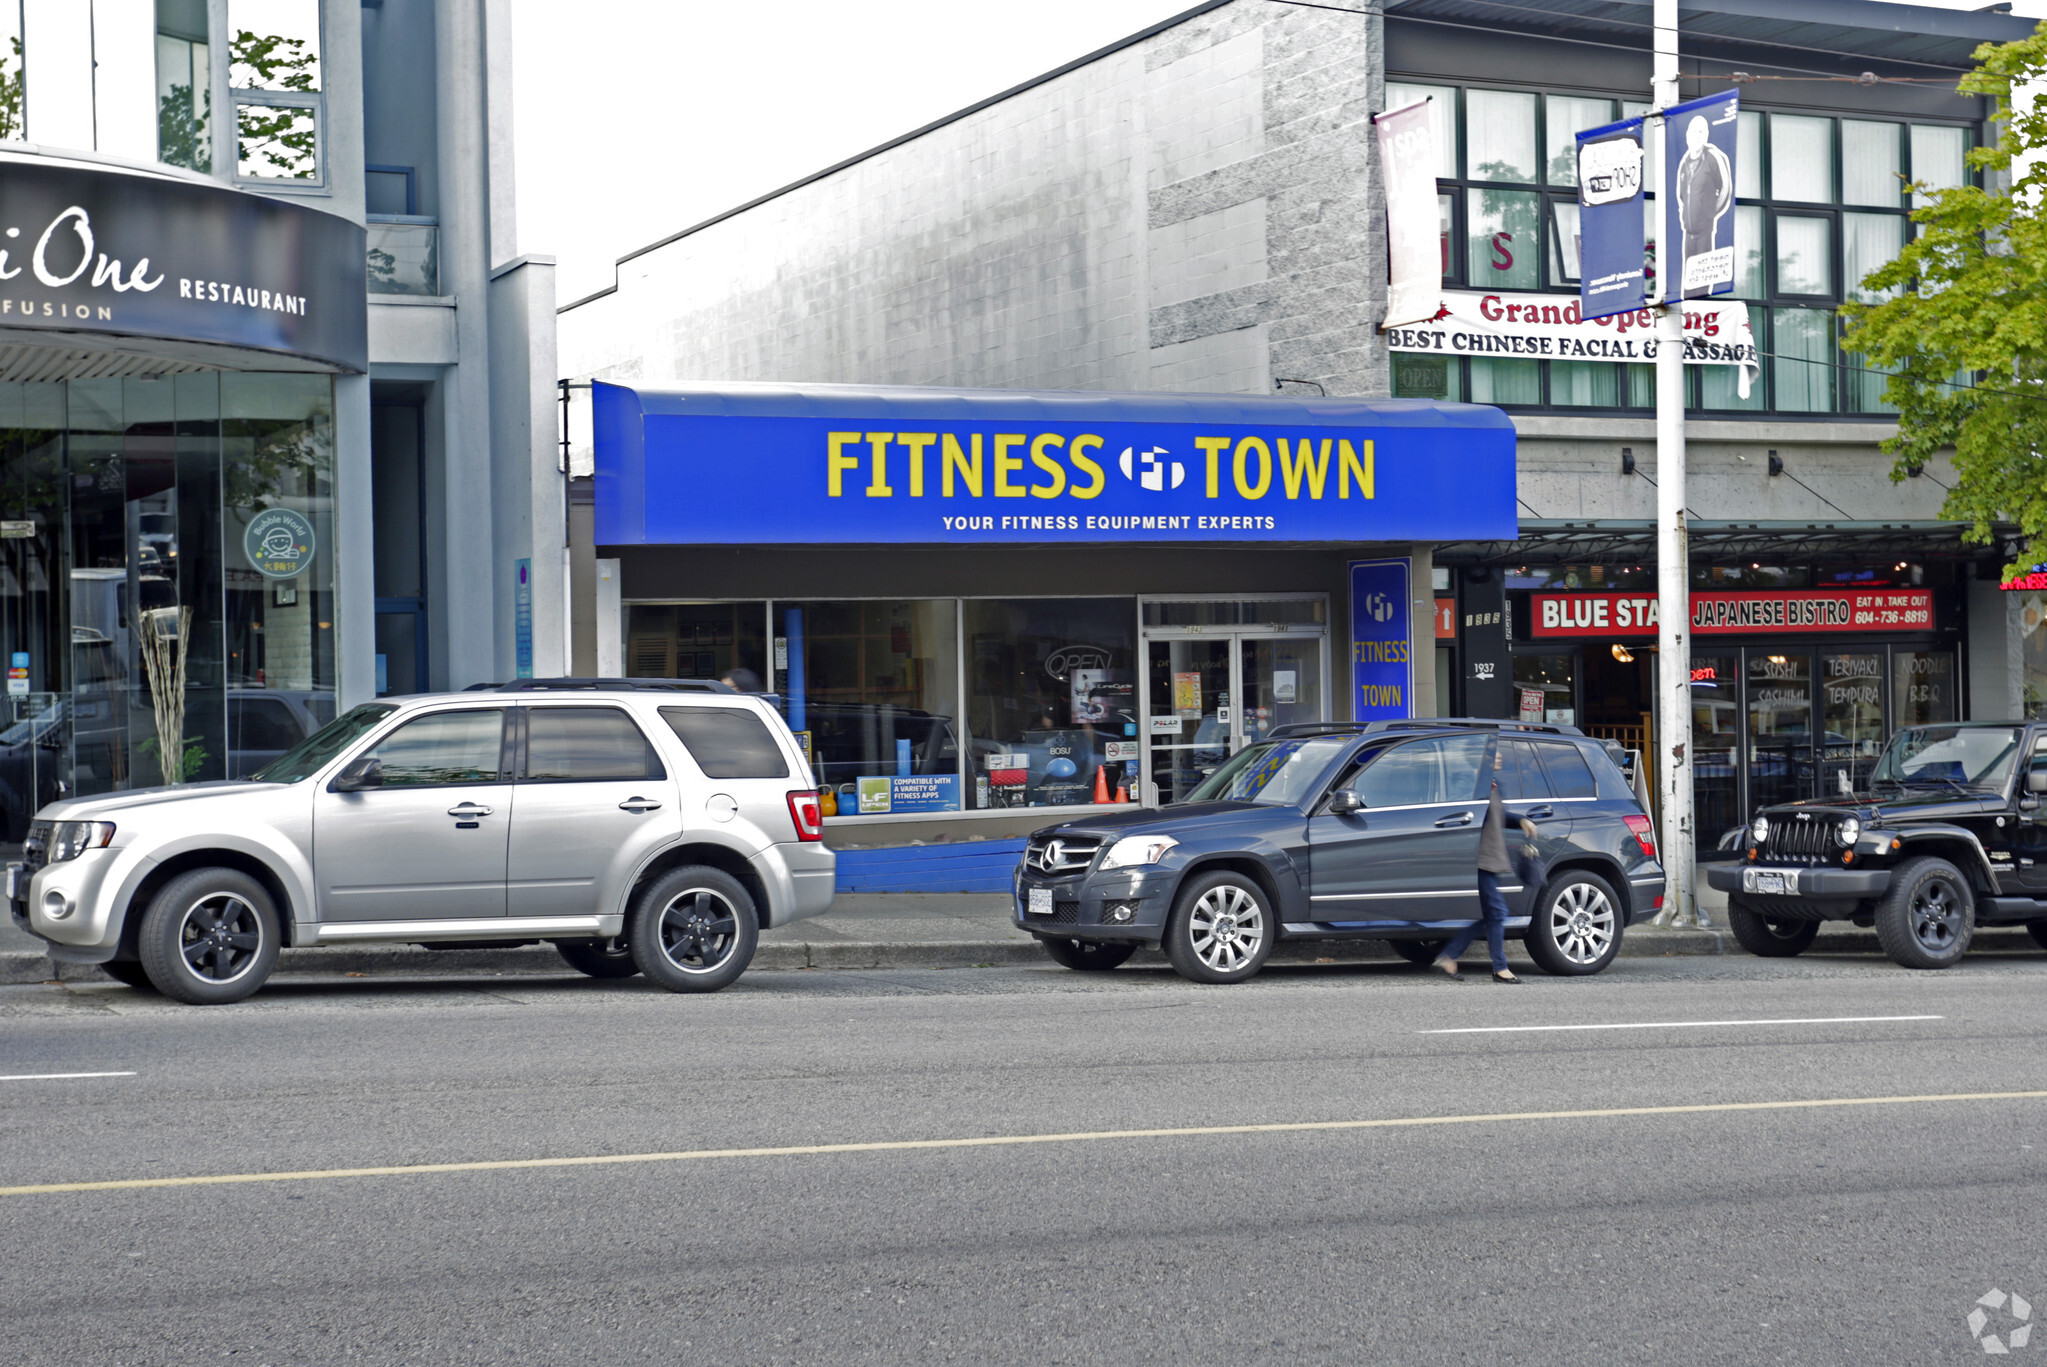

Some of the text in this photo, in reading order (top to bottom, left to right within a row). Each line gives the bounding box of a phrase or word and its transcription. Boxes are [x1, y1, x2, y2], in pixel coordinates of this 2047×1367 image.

[179, 278, 306, 316] RESTAURANT
[2, 299, 112, 321] FUSION
[1480, 295, 1583, 325] Grand
[1389, 329, 1446, 349] BEST
[1451, 332, 1552, 355] CHINESE
[1558, 338, 1638, 358] FACIAL
[1682, 341, 1758, 363] ASSAGE
[828, 432, 1105, 499] FITNESS
[1195, 436, 1374, 500] TOWN
[253, 515, 306, 536] Bubble World
[943, 516, 1275, 530] YOUR FITNESS EQUIPMENT EXPERTS
[1856, 597, 1872, 607] EAT
[1887, 596, 1908, 607] TAKE
[1911, 596, 1928, 606] OUT
[1542, 598, 1850, 628] BLUE STA JAPANESE BISTRO
[1855, 611, 1928, 624] 604-736-8819
[1354, 640, 1408, 663] FITNESS
[1474, 663, 1495, 673] 1937
[1764, 661, 1798, 678] SUSHI
[1829, 659, 1878, 676] TERIYAKI
[1902, 657, 1946, 674] NOODLE
[1362, 685, 1402, 707] TOWN
[1758, 689, 1805, 707] SASHIMI
[1829, 685, 1879, 704] TEMPURA
[1154, 719, 1178, 727] POLAR
[1050, 747, 1071, 755] BOSU
[894, 777, 951, 786] COMPATIBLE WITH
[928, 784, 938, 792] OF
[894, 791, 939, 800] FITNESS APPS
